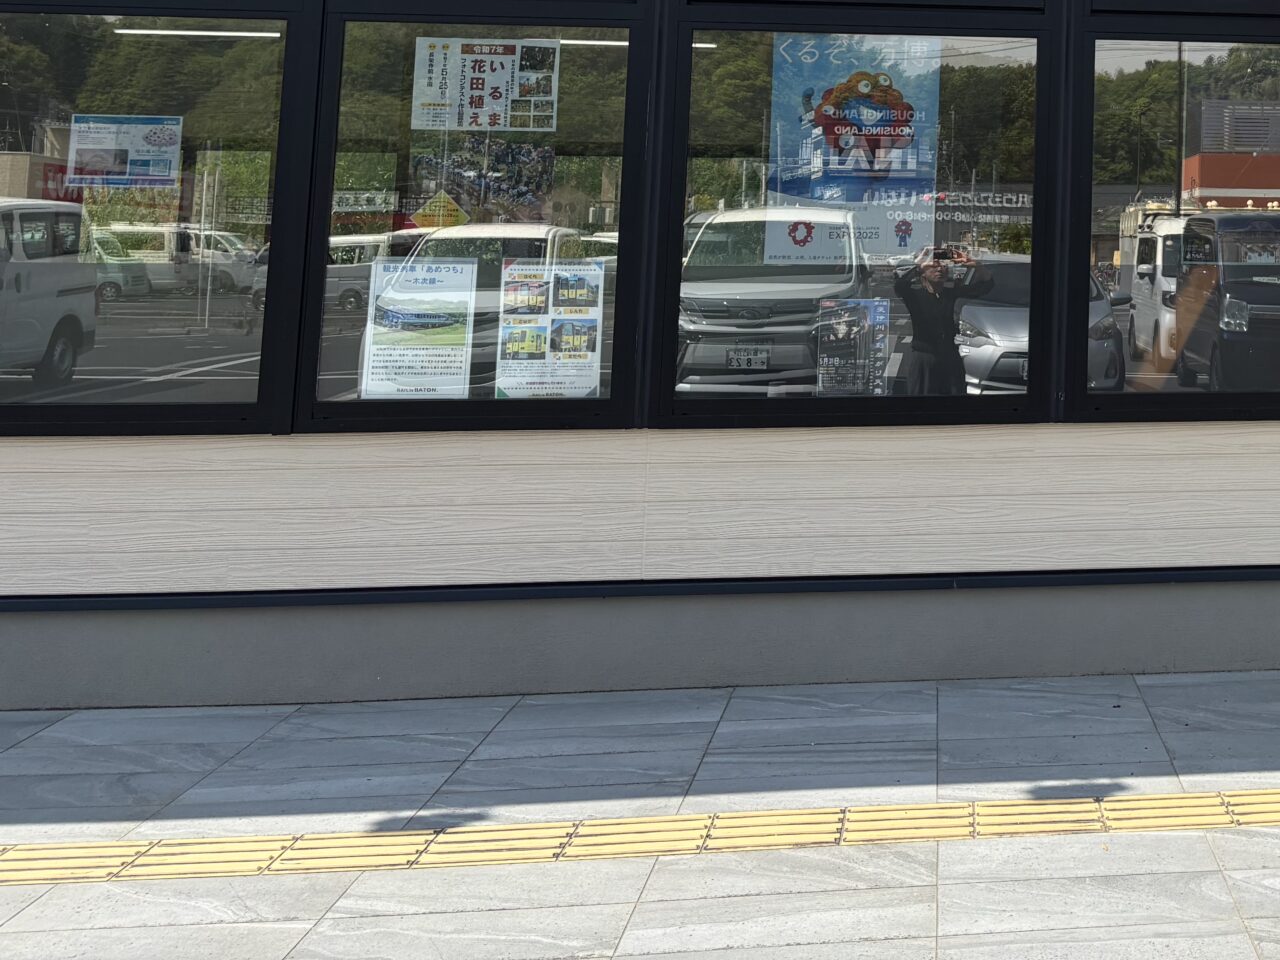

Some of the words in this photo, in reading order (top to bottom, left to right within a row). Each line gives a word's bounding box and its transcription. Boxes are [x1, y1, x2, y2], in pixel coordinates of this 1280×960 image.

[473, 45, 505, 54] 令和7年
[779, 38, 942, 68] くるぞ、万博。
[468, 58, 487, 127] 花田植え
[487, 59, 505, 127] いるま
[828, 231, 881, 240] EXPO2025
